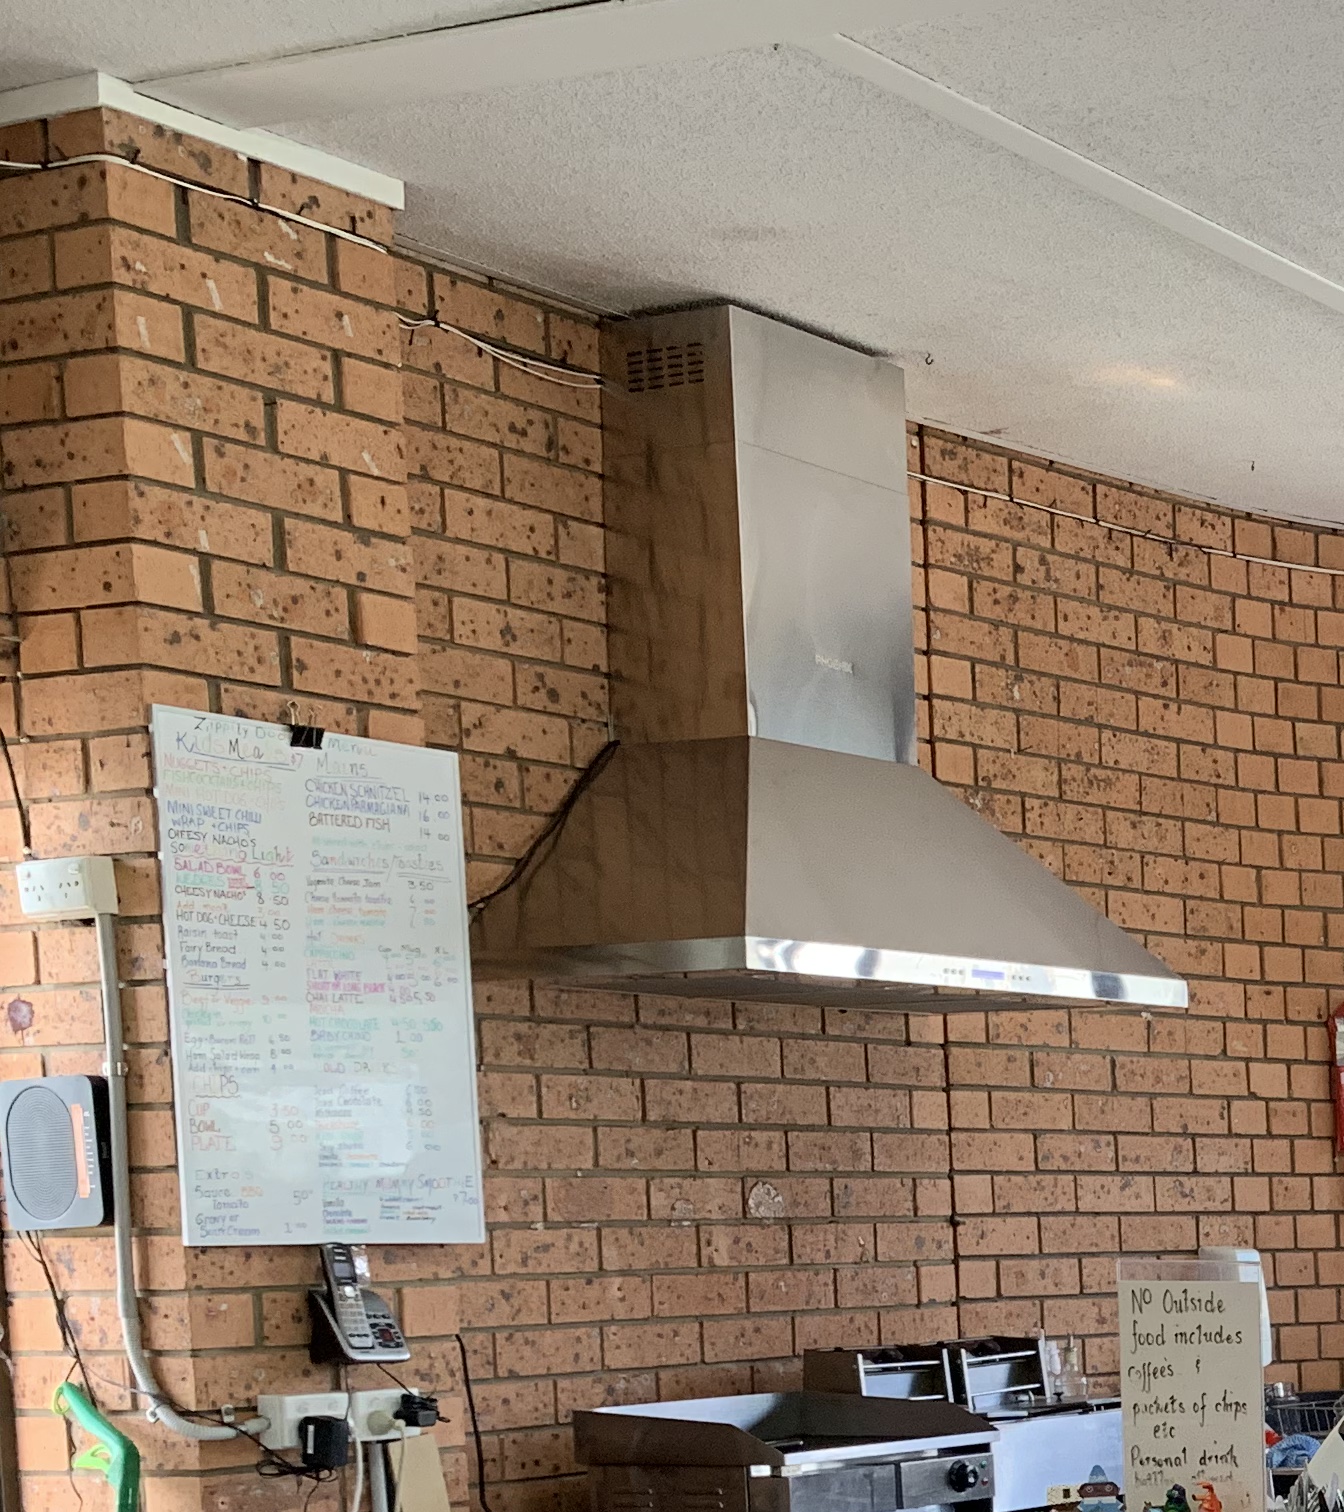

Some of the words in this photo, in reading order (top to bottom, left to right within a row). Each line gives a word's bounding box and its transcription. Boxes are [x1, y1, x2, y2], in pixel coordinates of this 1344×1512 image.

[1162, 1287, 1226, 1314] Outside
[1130, 1319, 1166, 1355] food
[1174, 1323, 1243, 1345] includes
[1132, 1394, 1186, 1427] packets
[1192, 1392, 1207, 1428] of
[1214, 1389, 1248, 1422] chips
[1130, 1445, 1187, 1468] Personal
[1199, 1440, 1239, 1468] drink
